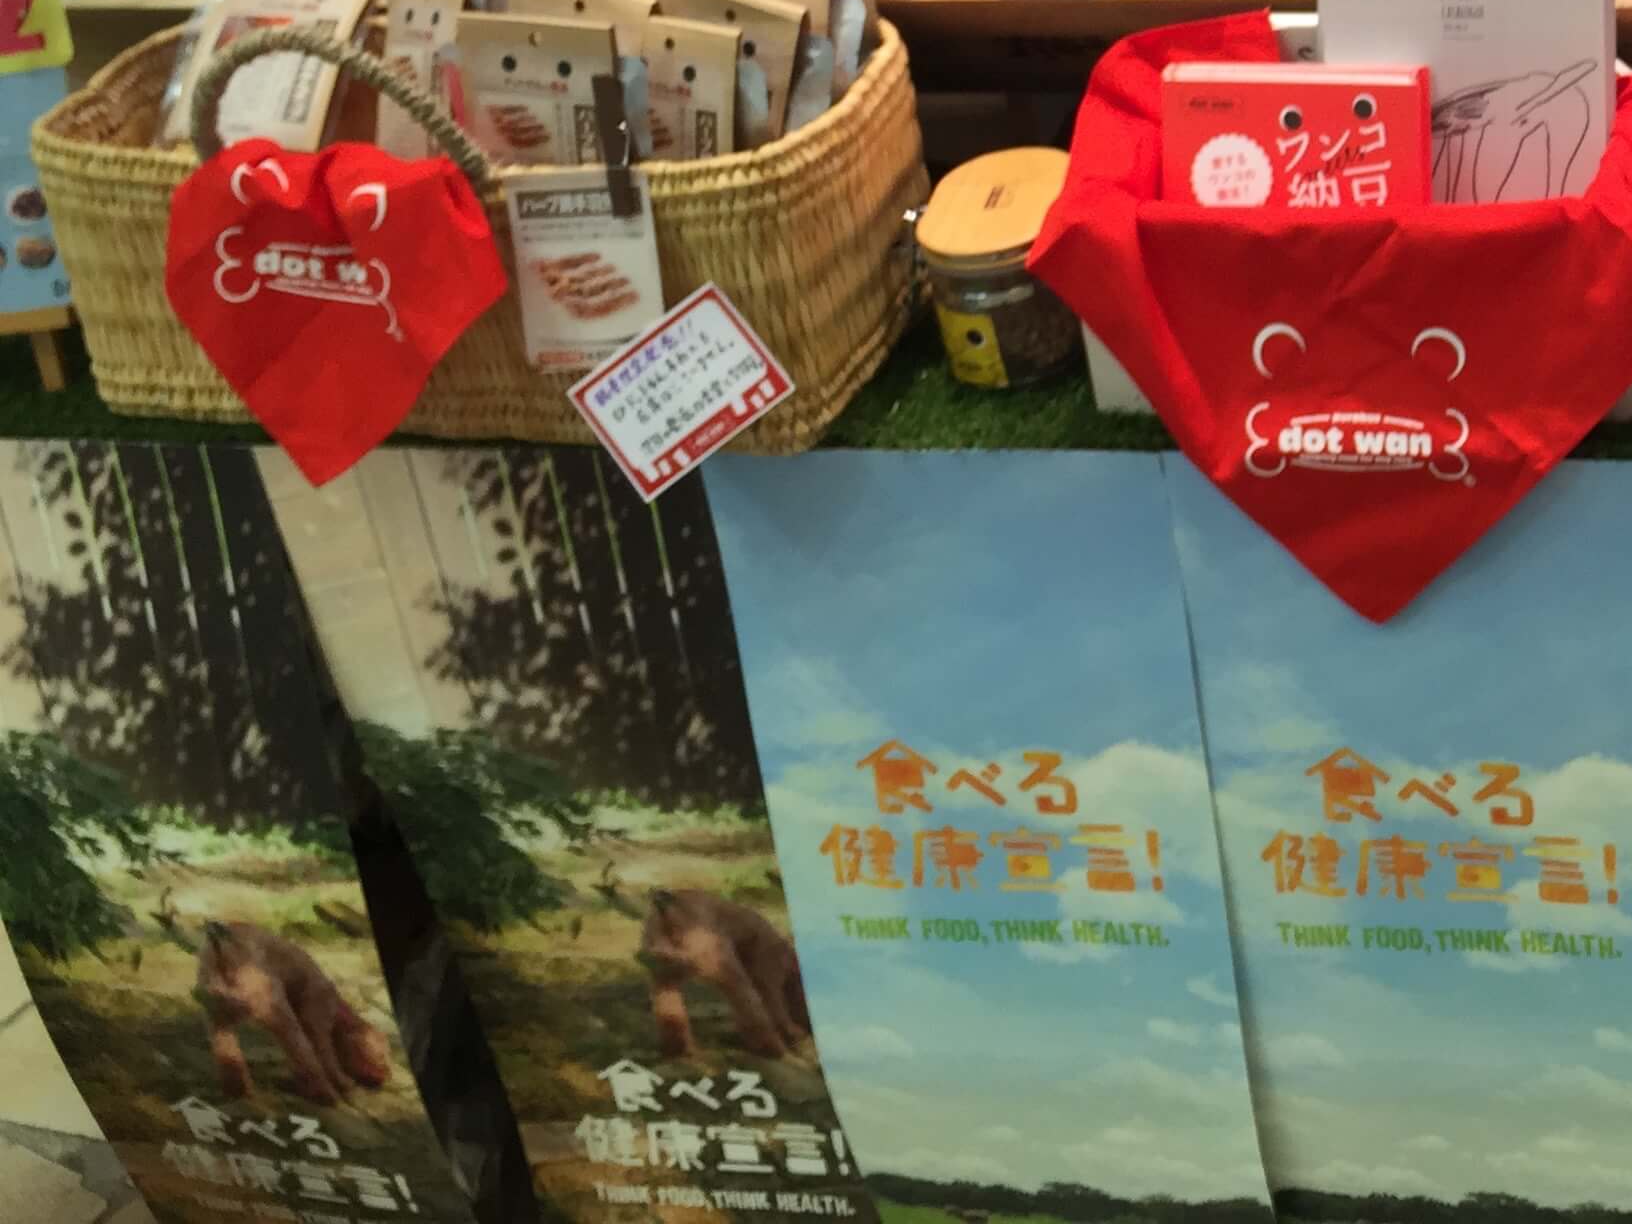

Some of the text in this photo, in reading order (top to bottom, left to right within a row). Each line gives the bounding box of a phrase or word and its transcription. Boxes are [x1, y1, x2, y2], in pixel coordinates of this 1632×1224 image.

[1276, 121, 1387, 173] ワンコ
[254, 249, 323, 283] dot
[1279, 425, 1433, 457] dot wan
[856, 739, 1079, 816] 食べる
[1305, 746, 1535, 827] 食べる
[819, 823, 1165, 893] 健康宣言！
[1261, 829, 1620, 905] 健康宣言！
[841, 915, 911, 940] THINK
[994, 919, 1063, 944] THINK
[1072, 921, 1171, 947] HEALTH.
[1277, 922, 1351, 948] THINK
[1435, 928, 1509, 953] THINK
[1521, 930, 1623, 960] HEALTH.
[597, 1058, 778, 1118] 食べる
[169, 1095, 340, 1160] 食べる
